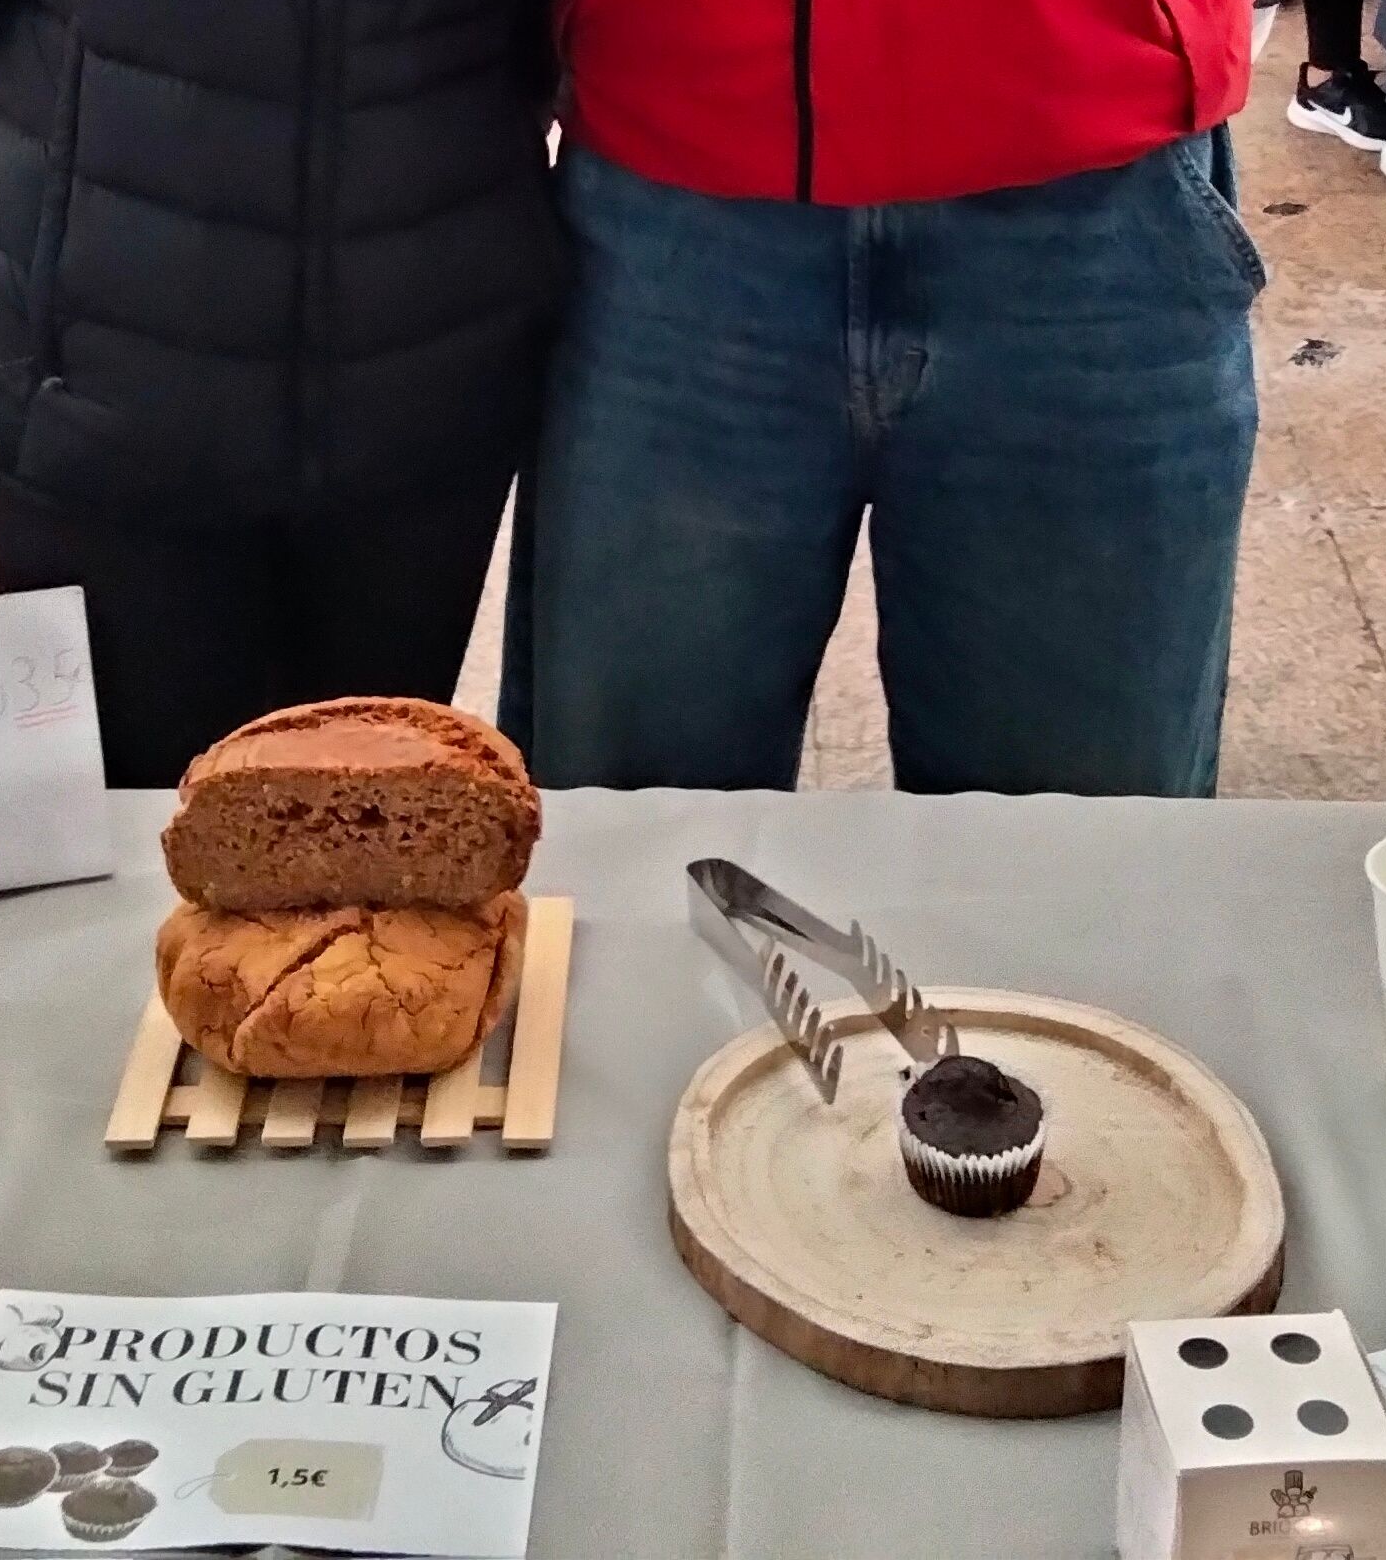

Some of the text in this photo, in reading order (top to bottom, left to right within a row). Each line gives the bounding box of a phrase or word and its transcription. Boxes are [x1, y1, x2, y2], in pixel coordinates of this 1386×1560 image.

[53, 1322, 482, 1365] PRODUCTOS
[28, 1368, 467, 1411] SIN GLUTEN
[268, 1467, 330, 1489] 1,5€
